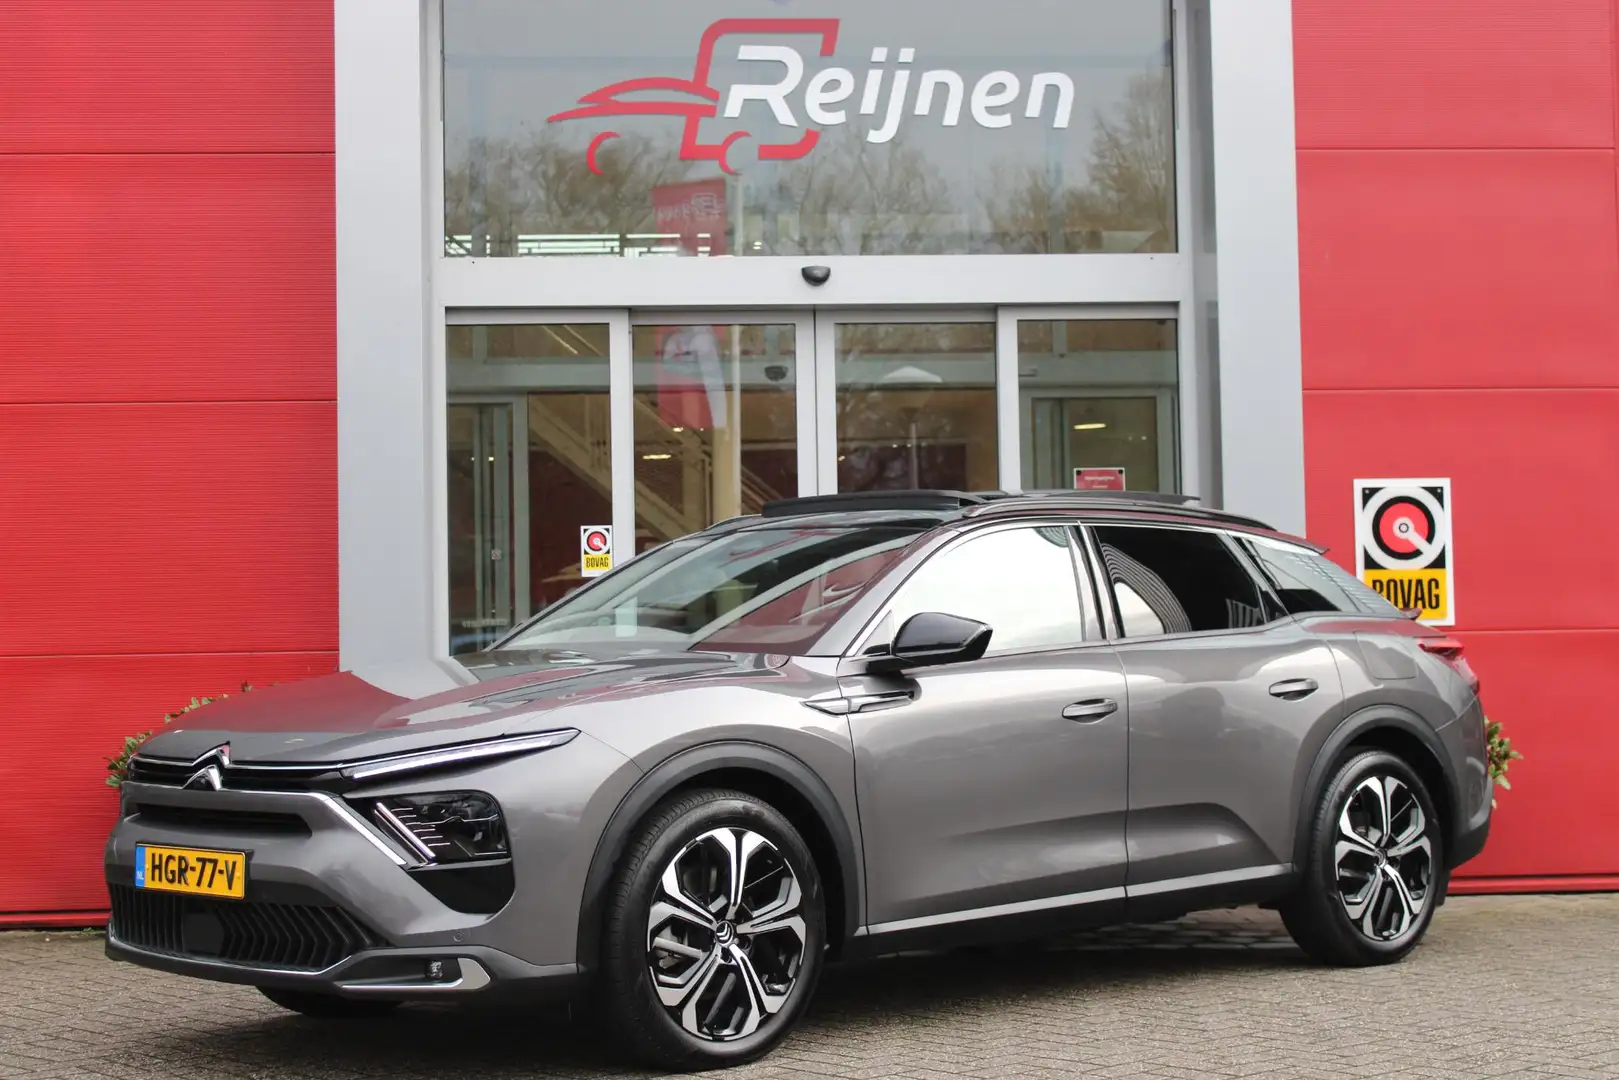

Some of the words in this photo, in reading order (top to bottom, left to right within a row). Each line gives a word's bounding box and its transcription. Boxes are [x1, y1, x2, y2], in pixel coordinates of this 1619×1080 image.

[723, 45, 1075, 143] Reijnen
[586, 557, 609, 568] BOVAG
[136, 870, 144, 880] NL
[151, 853, 237, 891] HGR-77-V
